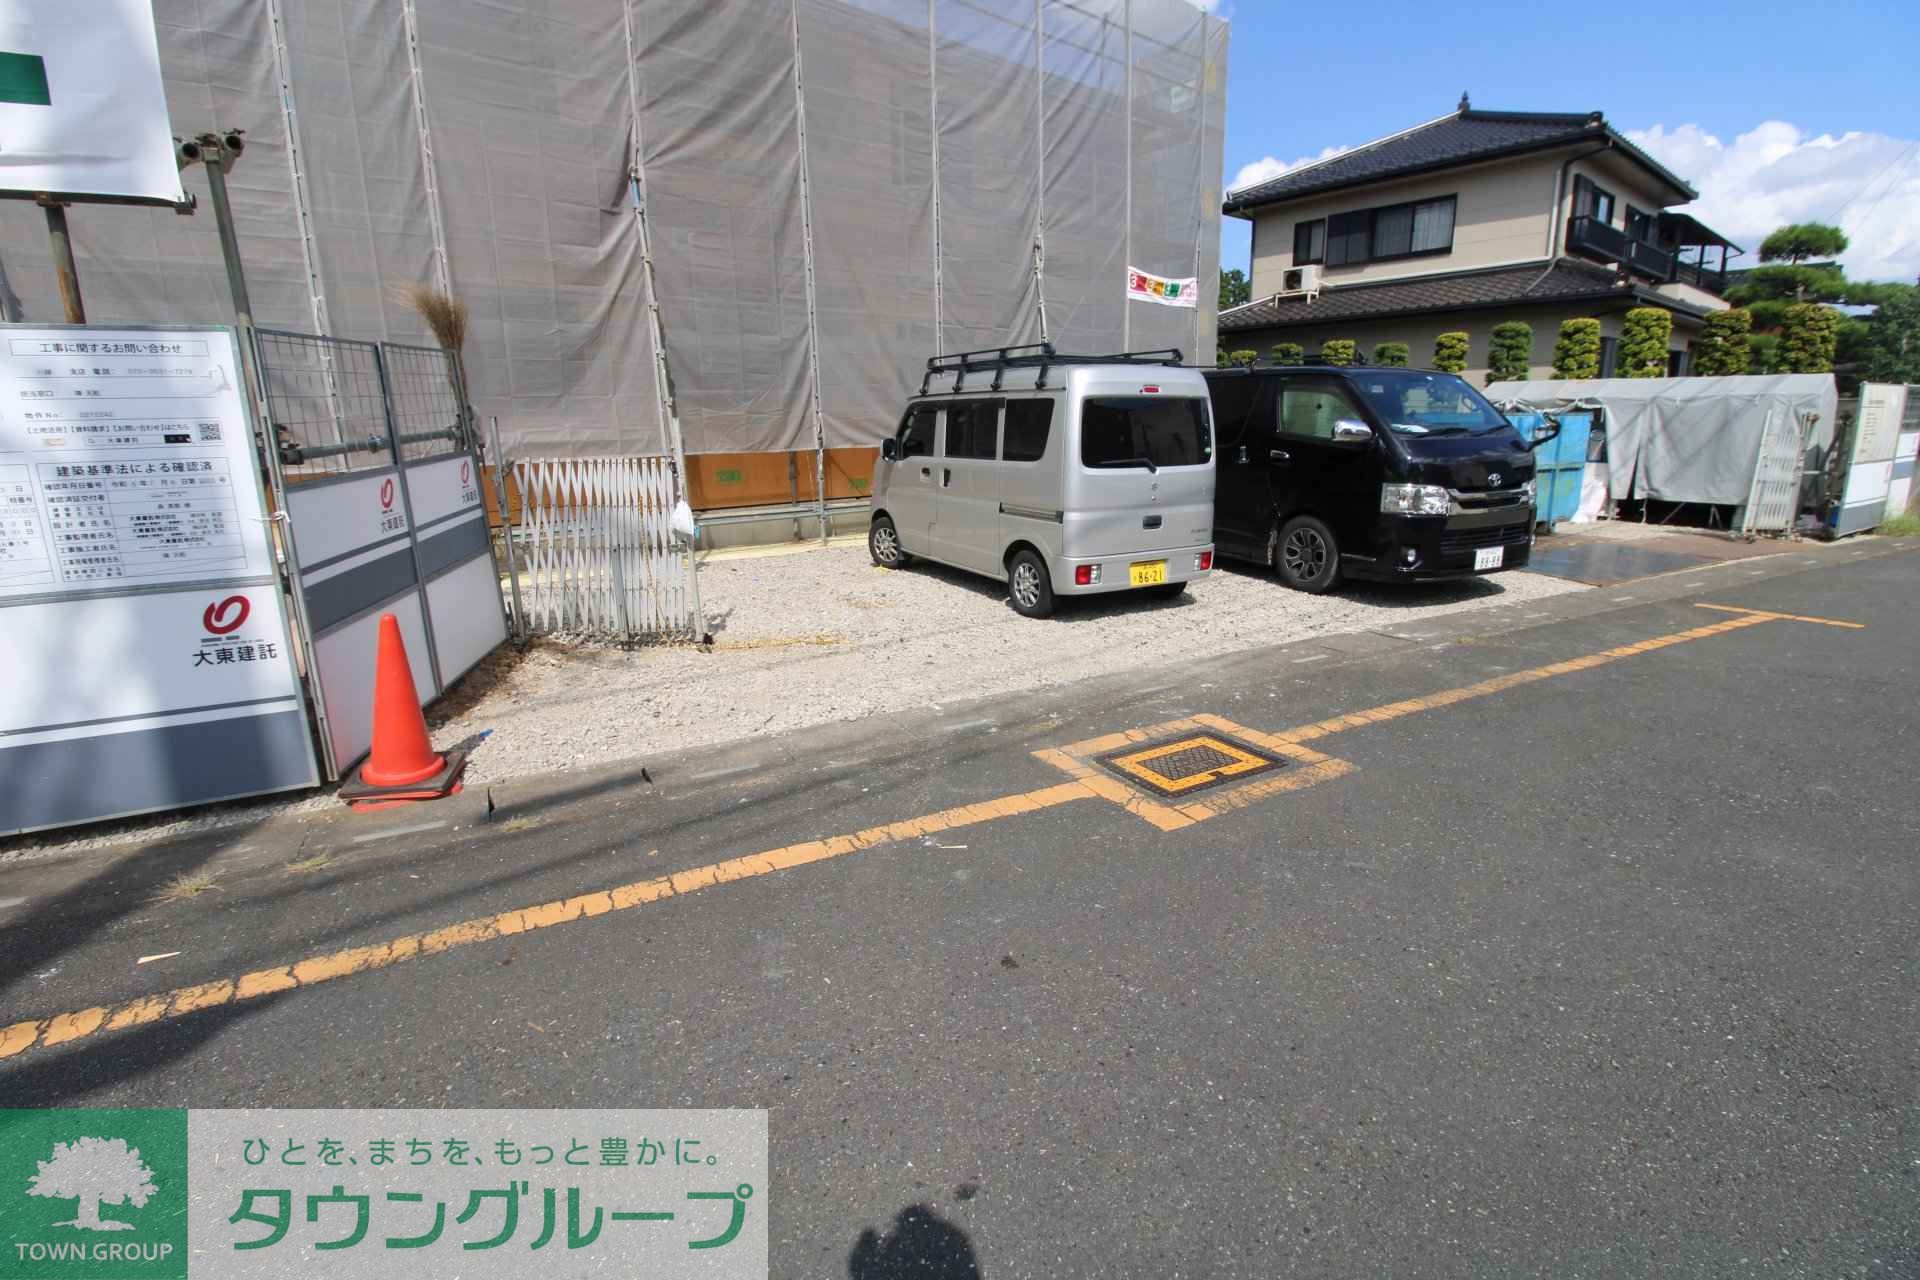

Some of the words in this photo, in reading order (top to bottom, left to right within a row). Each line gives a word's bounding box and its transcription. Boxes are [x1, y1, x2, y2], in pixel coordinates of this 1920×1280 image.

[40, 343, 181, 354] 工事に関するお問い合わせ
[56, 461, 213, 477] 建築基準法による確認済
[192, 643, 277, 667] 大東建託
